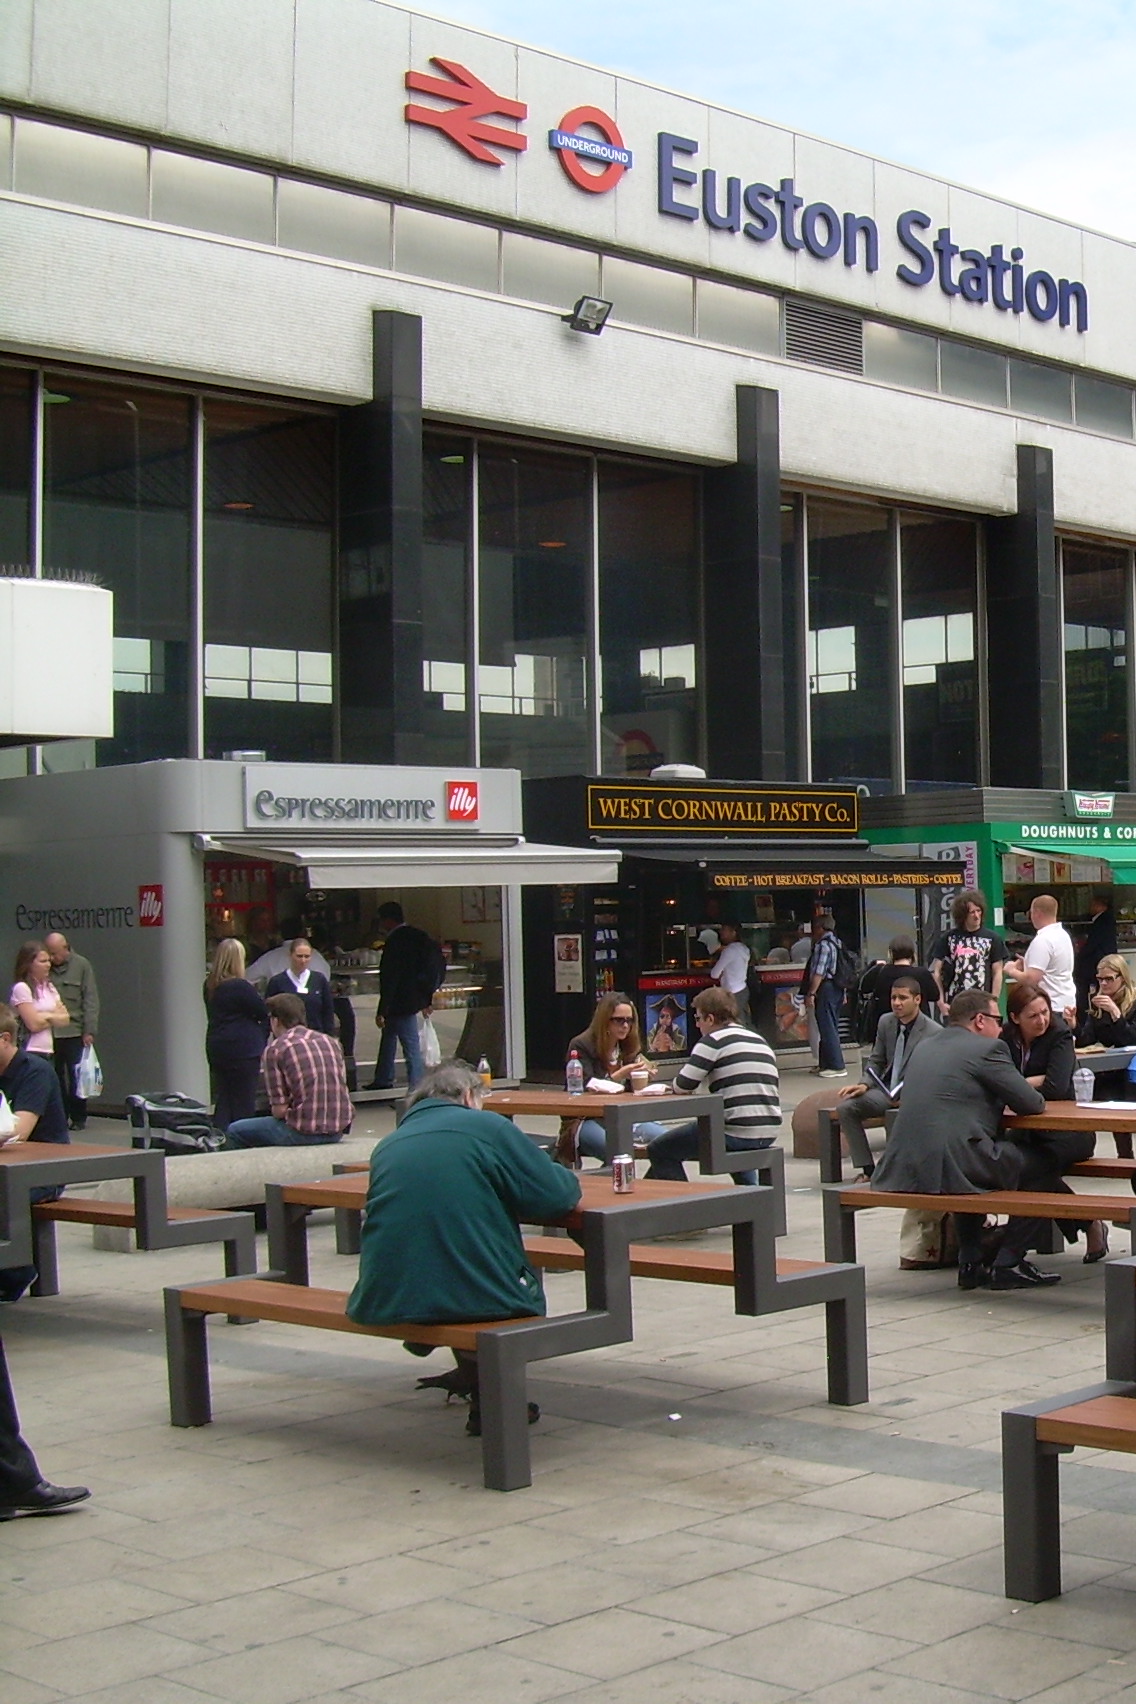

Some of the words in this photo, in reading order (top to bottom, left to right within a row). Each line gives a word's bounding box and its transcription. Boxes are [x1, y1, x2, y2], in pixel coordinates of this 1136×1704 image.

[557, 133, 629, 163] UNDERGROUND
[657, 131, 879, 272] Euston
[897, 209, 1088, 333] Station
[255, 789, 436, 821] espressamente
[449, 787, 476, 816] illy
[598, 797, 654, 819] WEST
[658, 798, 766, 822] CORNWALL
[769, 802, 824, 823] PASTY
[1021, 825, 1098, 839] DOUGHNUTS
[1103, 827, 1111, 839] &
[714, 875, 749, 886] COFFEE
[753, 875, 774, 886] HOT
[775, 874, 824, 886] BREAKFAST
[831, 874, 860, 885] BACON
[861, 874, 889, 885] ROLLS
[893, 874, 929, 884] PASTRIES
[933, 873, 963, 884] COFFEE
[140, 891, 162, 923] illy
